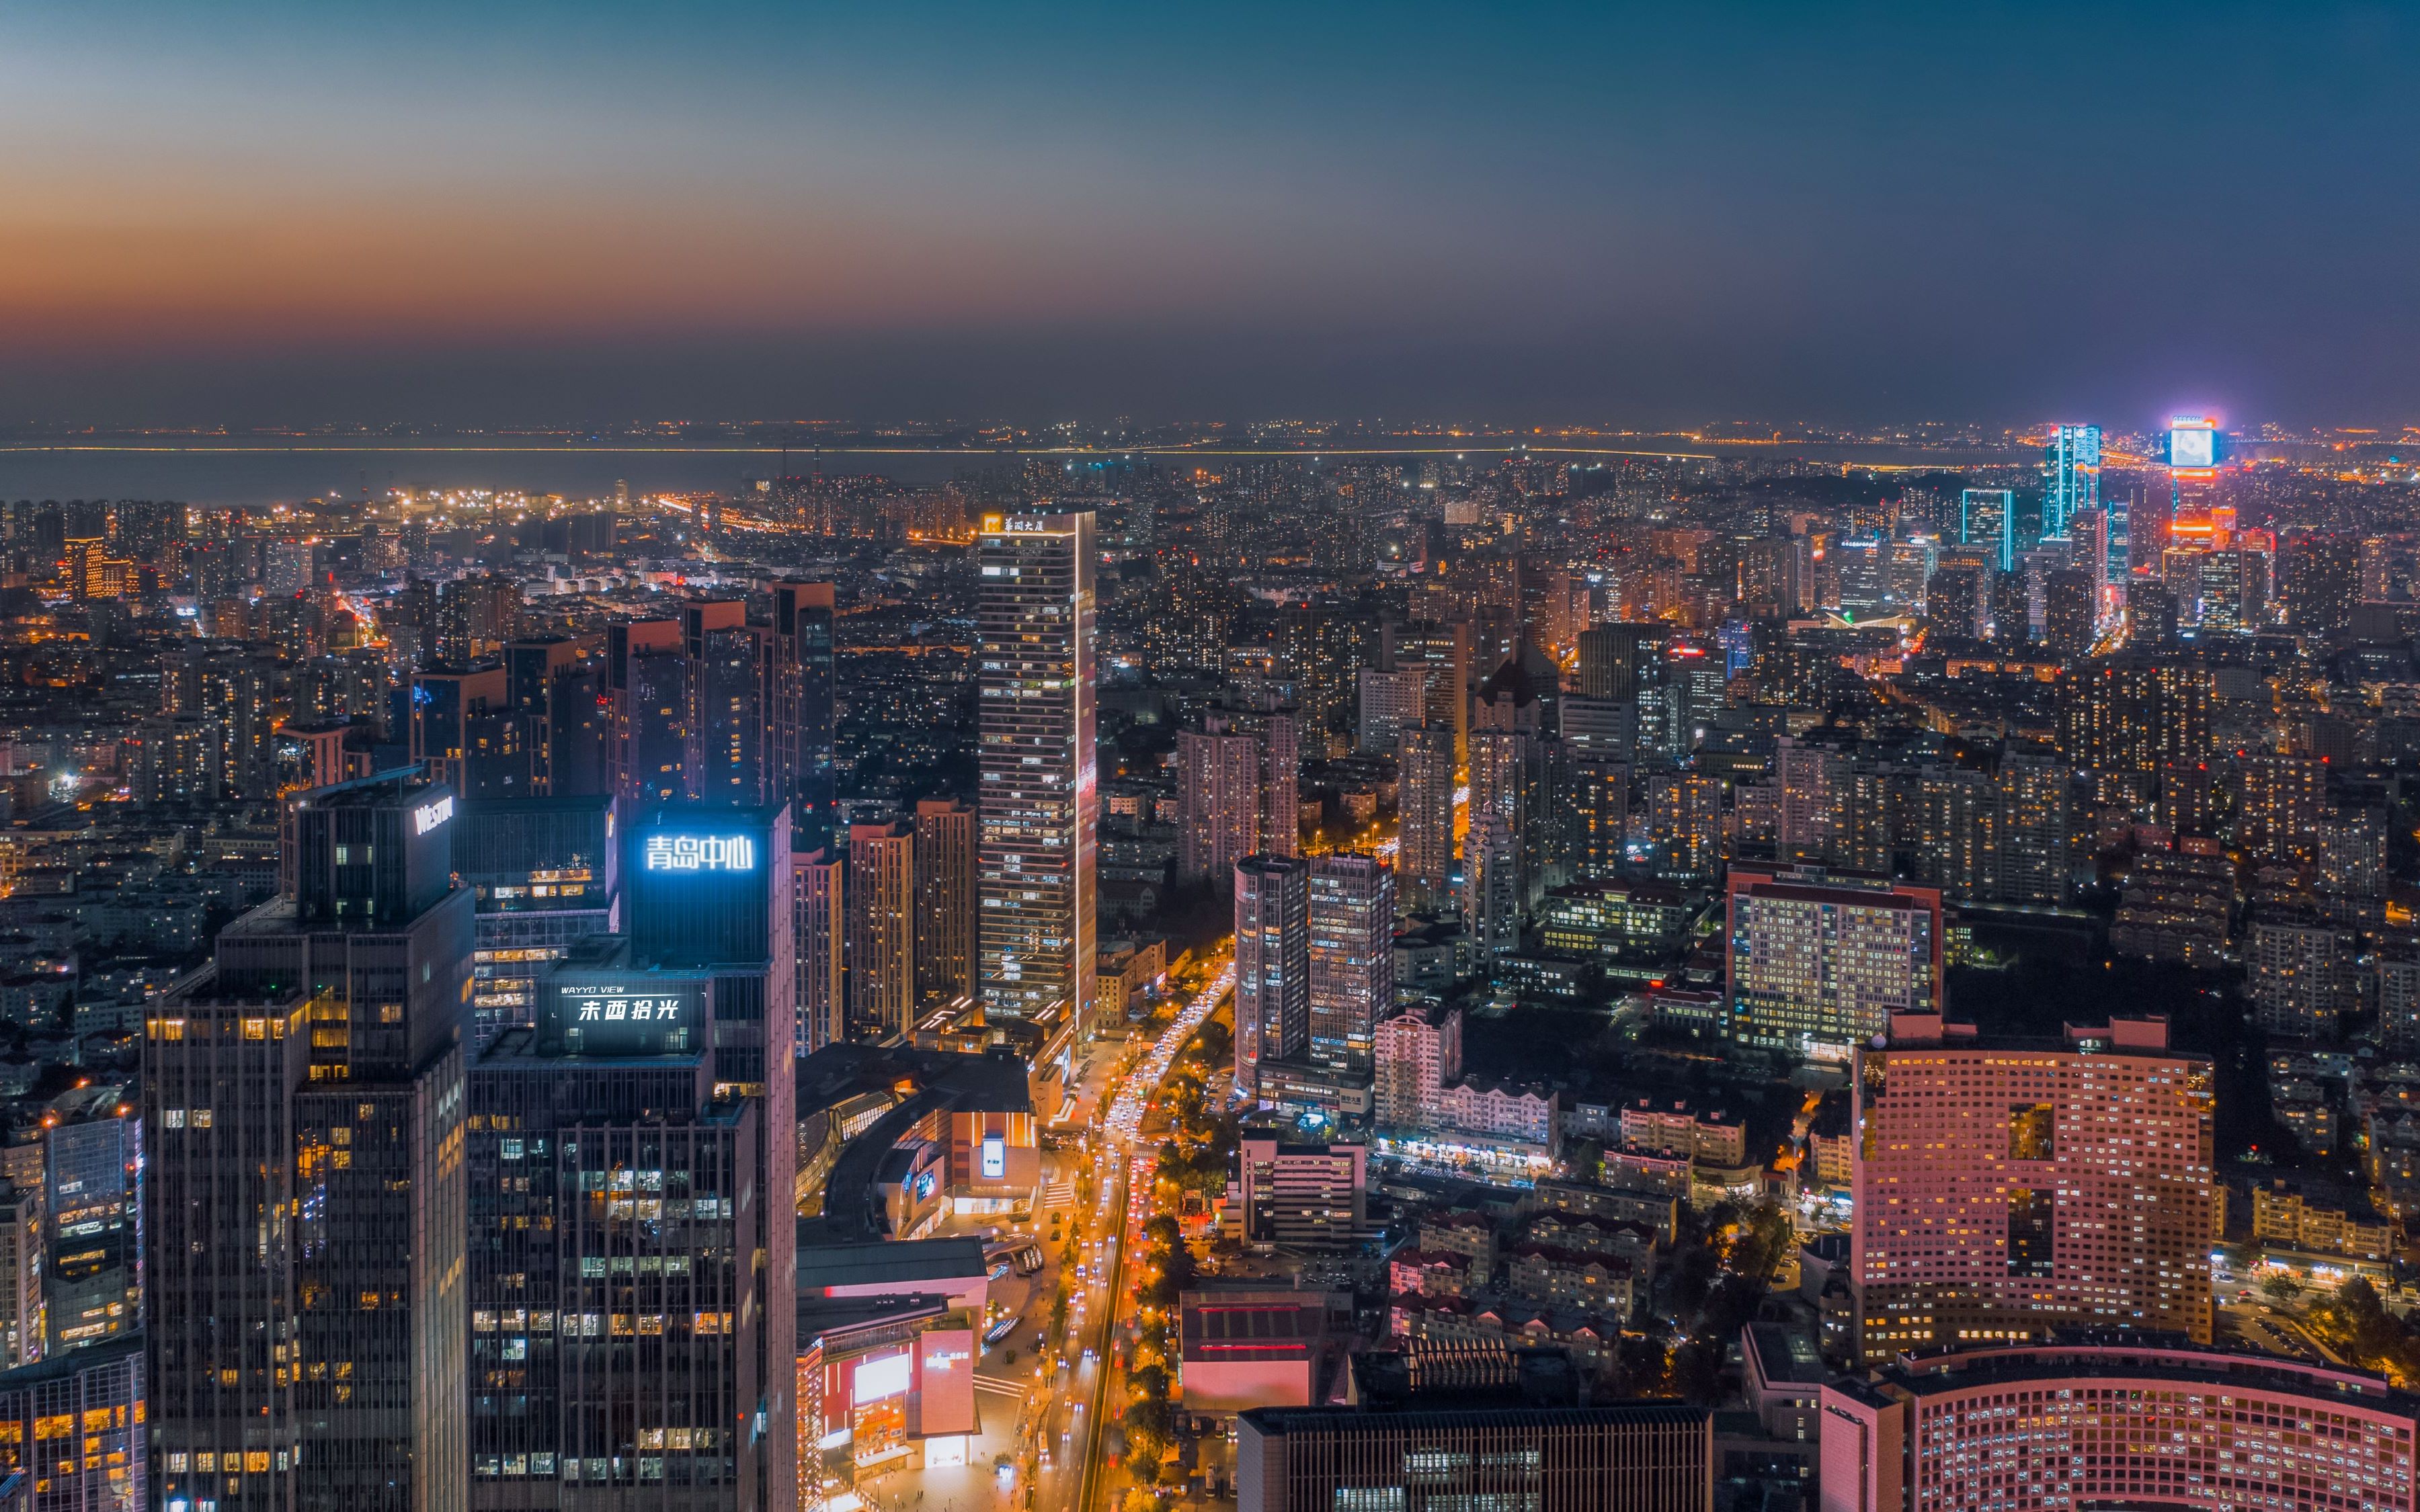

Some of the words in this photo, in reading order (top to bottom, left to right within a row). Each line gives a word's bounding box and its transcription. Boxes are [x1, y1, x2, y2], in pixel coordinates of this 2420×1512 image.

[647, 835, 753, 870] 青岛中心
[579, 999, 679, 1021] 未酉拾光
